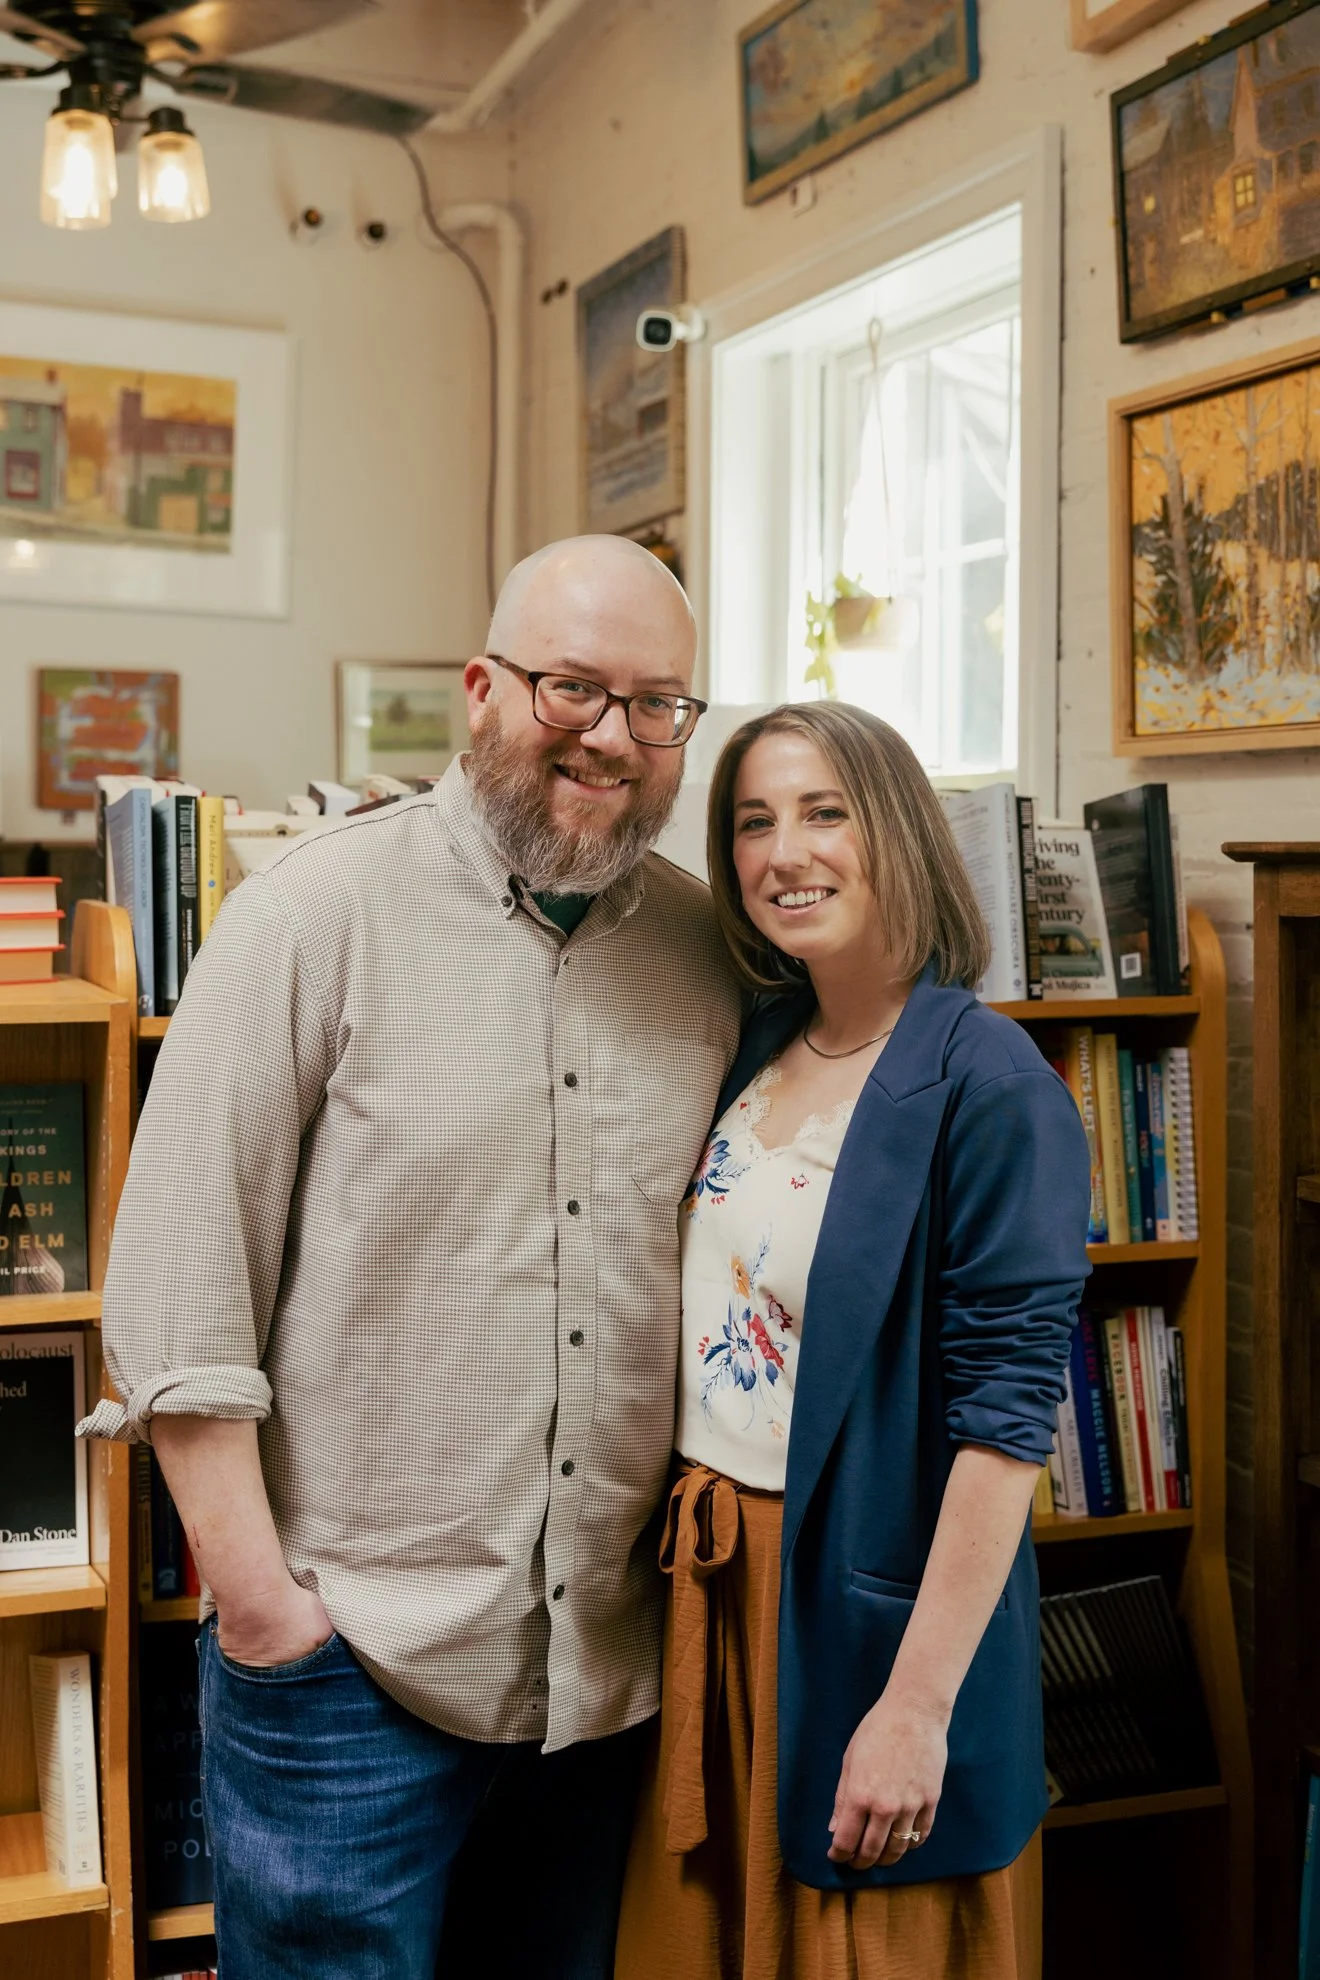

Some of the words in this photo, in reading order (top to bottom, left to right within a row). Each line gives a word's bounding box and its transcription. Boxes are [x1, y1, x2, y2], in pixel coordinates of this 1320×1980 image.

[180, 846, 196, 884] GROUND
[209, 840, 218, 876] Andrew
[180, 885, 196, 898] UP
[1010, 918, 1020, 969] OBSCURA
[1079, 1035, 1093, 1092] WHAT'S
[22, 1127, 35, 1136] OF
[38, 1127, 57, 1135] THE
[1082, 1096, 1096, 1132] LEFT
[8, 1201, 54, 1219] ASH
[19, 1233, 65, 1249] ELM
[13, 1265, 47, 1275] PRICE
[0, 1342, 74, 1360] olocaust
[1159, 1368, 1169, 1408] Chilling
[1090, 1388, 1105, 1439] MAGGIE
[1097, 1444, 1112, 1496] NELSON
[0, 1529, 31, 1544] Dan
[33, 1526, 78, 1541] Stone
[69, 1668, 83, 1743] WONDERS
[73, 1761, 89, 1833] RARITIES
